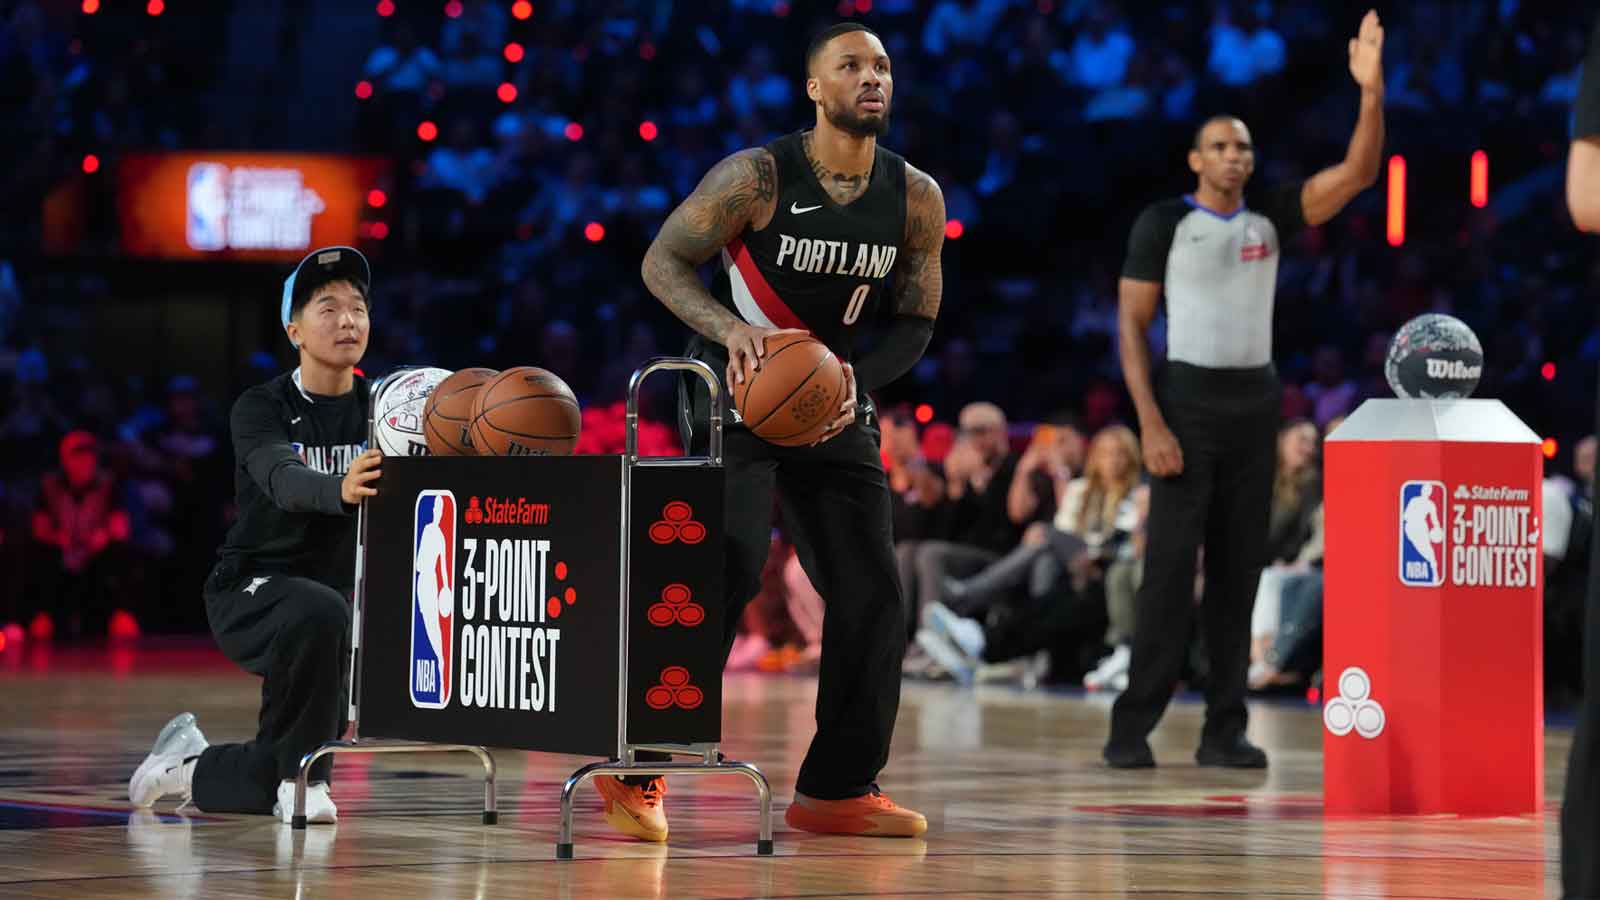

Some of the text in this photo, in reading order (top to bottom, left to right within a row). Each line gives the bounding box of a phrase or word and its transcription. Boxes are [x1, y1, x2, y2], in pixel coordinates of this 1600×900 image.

[776, 233, 897, 279] PORTLAND
[842, 284, 871, 326] 0
[1452, 504, 1530, 546] 3-POINT
[462, 538, 550, 622] 3-POINT
[1406, 561, 1429, 580] NBA
[1452, 545, 1537, 588] CONTEST
[416, 659, 436, 693] NBA
[460, 624, 560, 712] CONTEST
